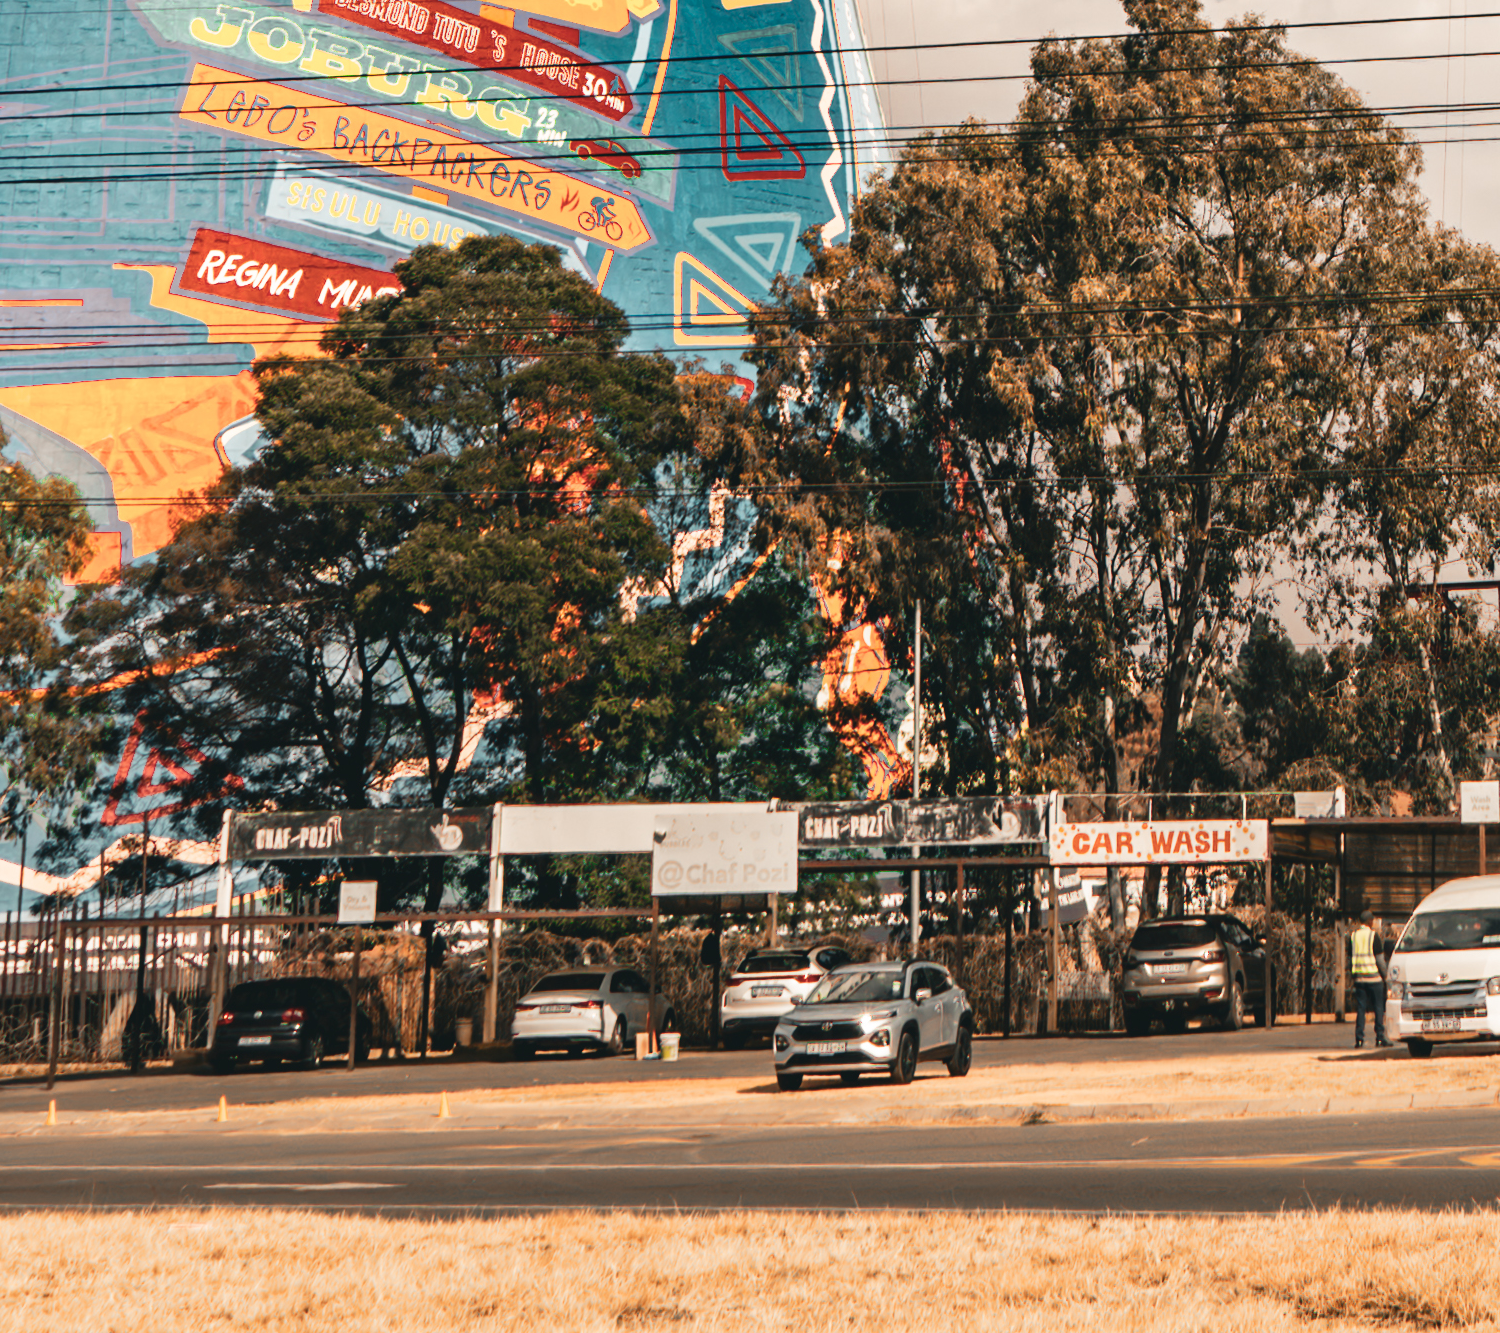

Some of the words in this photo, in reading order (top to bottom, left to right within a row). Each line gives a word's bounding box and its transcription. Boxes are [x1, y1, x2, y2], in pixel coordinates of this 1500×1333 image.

[188, 4, 533, 140] JOBURG
[433, 11, 481, 54] TUTU
[519, 41, 581, 91] HOUSE
[286, 181, 382, 228] SISULU
[392, 209, 475, 251] HOUS
[197, 249, 304, 300] REGINA
[1072, 832, 1134, 855] CAR
[1150, 830, 1232, 855] WASH
